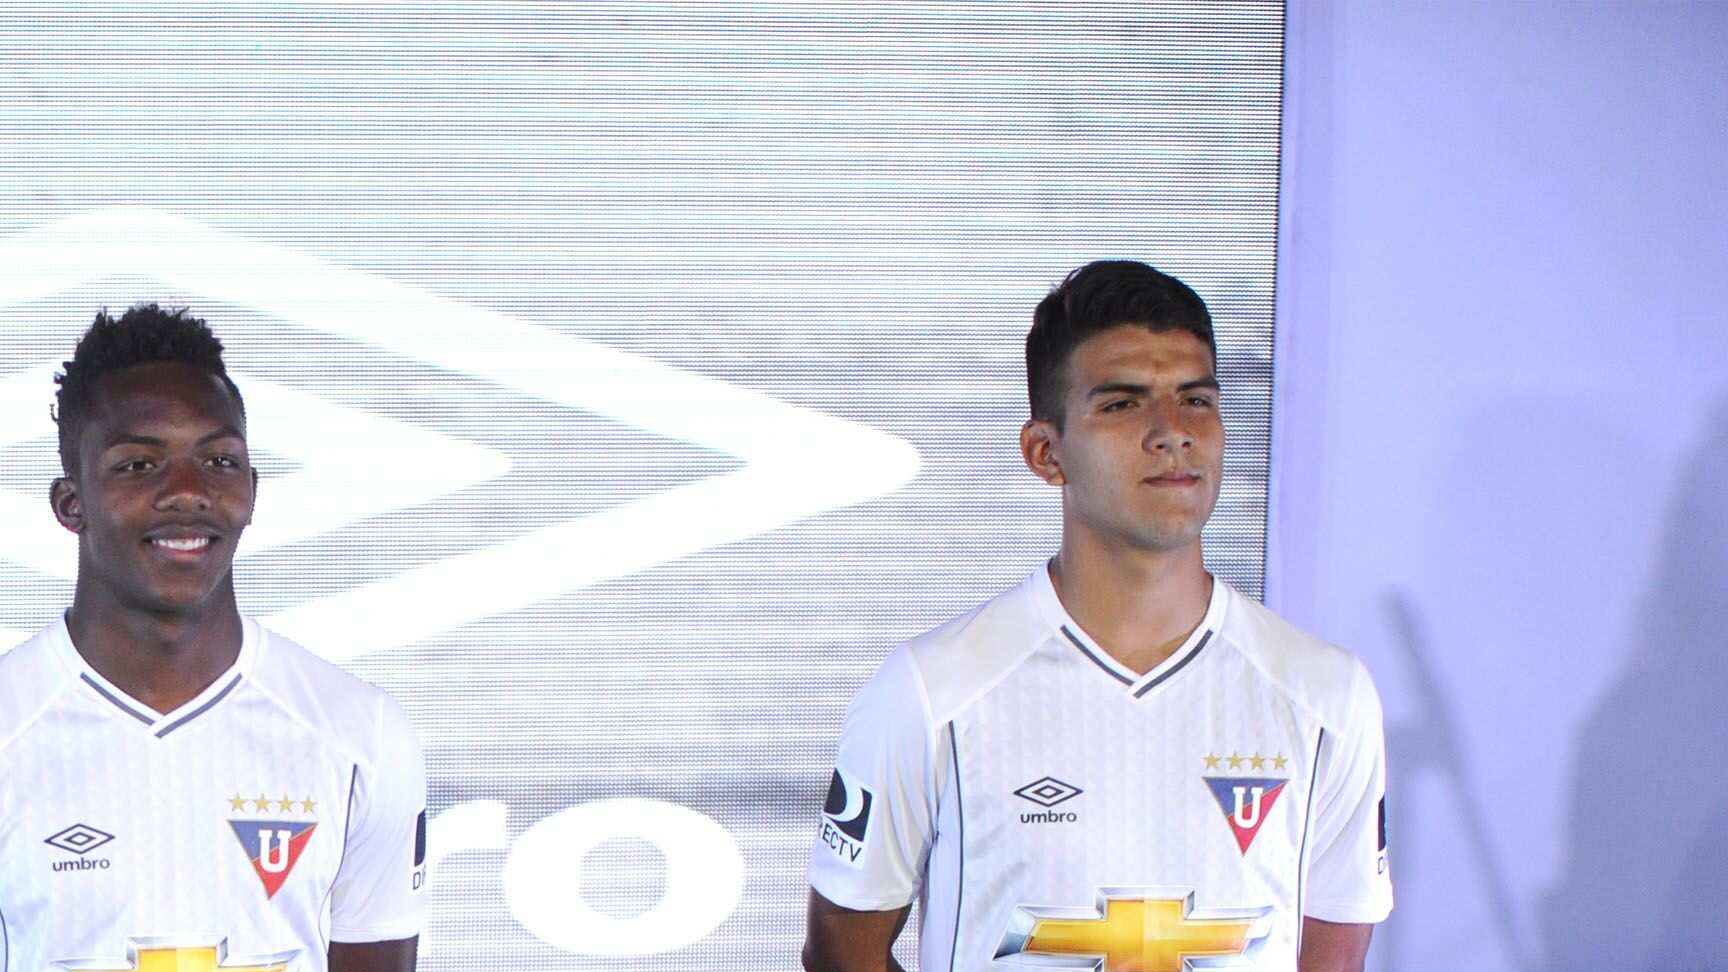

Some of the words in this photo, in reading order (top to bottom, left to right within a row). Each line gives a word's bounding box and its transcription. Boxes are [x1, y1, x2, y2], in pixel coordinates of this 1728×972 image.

[1020, 809, 1078, 824] umbro
[1232, 786, 1265, 829] U
[257, 829, 292, 872] U
[818, 817, 862, 863] ECTV
[52, 857, 111, 872] umbro
